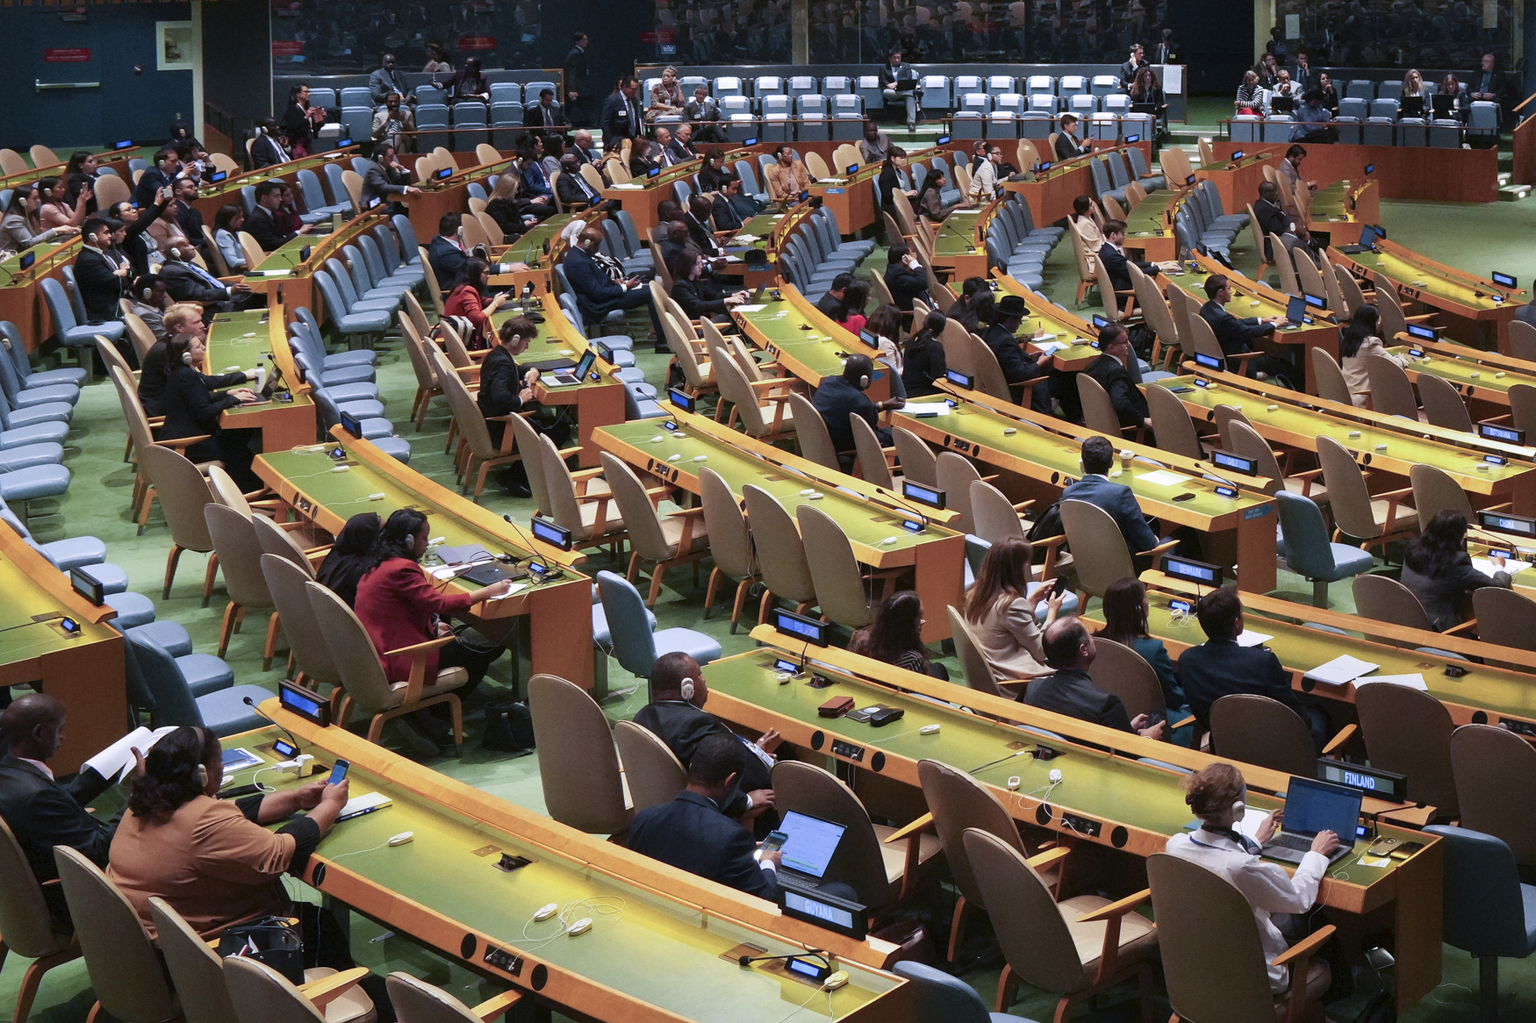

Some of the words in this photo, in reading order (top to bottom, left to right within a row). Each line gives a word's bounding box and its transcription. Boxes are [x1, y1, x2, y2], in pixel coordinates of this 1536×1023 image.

[1499, 518, 1515, 529] CHINA
[1179, 564, 1202, 578] DENMARK
[1344, 771, 1374, 790] FINLAND
[805, 899, 834, 922] GUYANA
